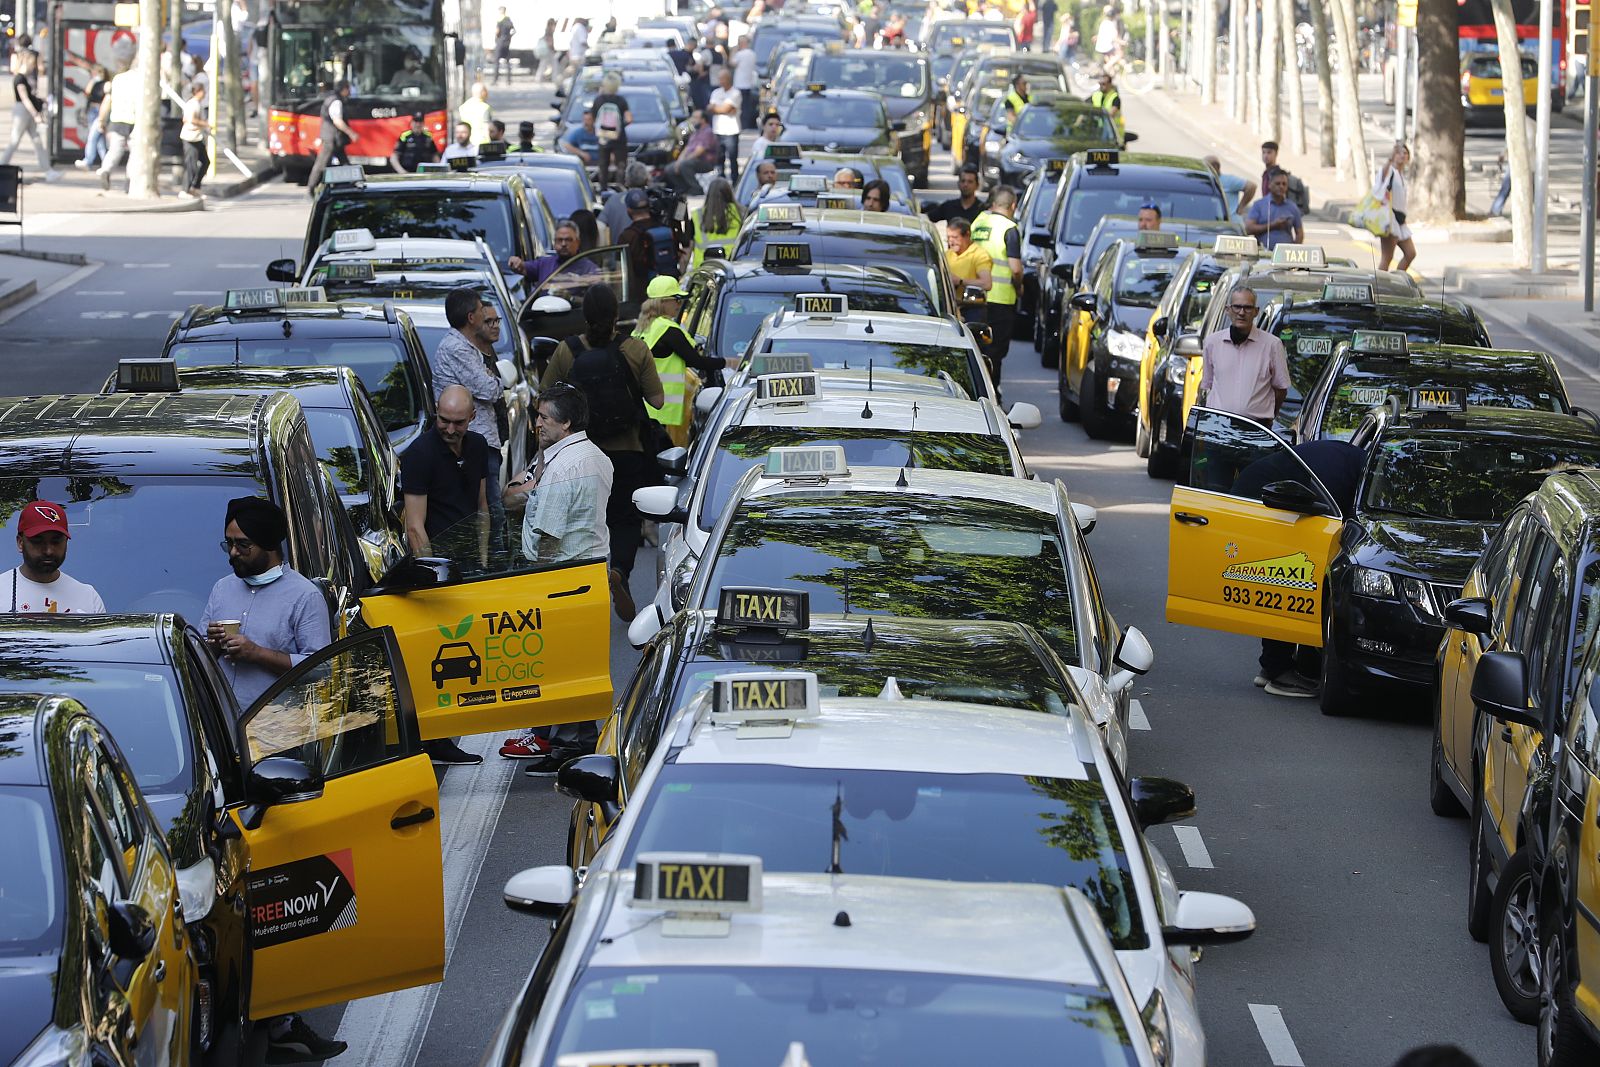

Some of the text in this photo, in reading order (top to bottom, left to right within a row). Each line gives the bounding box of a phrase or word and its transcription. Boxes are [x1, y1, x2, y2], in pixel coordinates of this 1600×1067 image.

[1093, 153, 1110, 161] TAXI
[768, 208, 788, 219] TAXI
[778, 246, 799, 259] TAXI
[1226, 240, 1244, 250] TAXI
[1285, 250, 1308, 262] TAXI
[338, 265, 358, 277] TAXI
[240, 291, 263, 305] TAXI
[288, 291, 308, 302] TAXI
[1335, 287, 1356, 300] TAXI
[806, 298, 832, 312] TAXI
[1299, 339, 1331, 354] OCUPAT
[1365, 335, 1389, 350] TAXI
[766, 358, 791, 371] TAXI
[133, 366, 160, 382] TAXI
[770, 378, 803, 396] TAXI
[1351, 389, 1385, 404] OCUPAT
[1420, 390, 1450, 406] TAXI
[785, 451, 819, 471] TAXI
[1229, 565, 1305, 580] BARNATAXI
[736, 594, 782, 620] TAXI
[1223, 585, 1315, 615] 933 222 222
[482, 607, 542, 635] TAXI
[485, 632, 544, 660] ECO
[485, 660, 545, 683] LÒGIC
[523, 688, 538, 697] Store
[732, 681, 786, 709] TAXI
[660, 865, 724, 899] TAXI
[254, 914, 319, 937] Muévete como quieras
